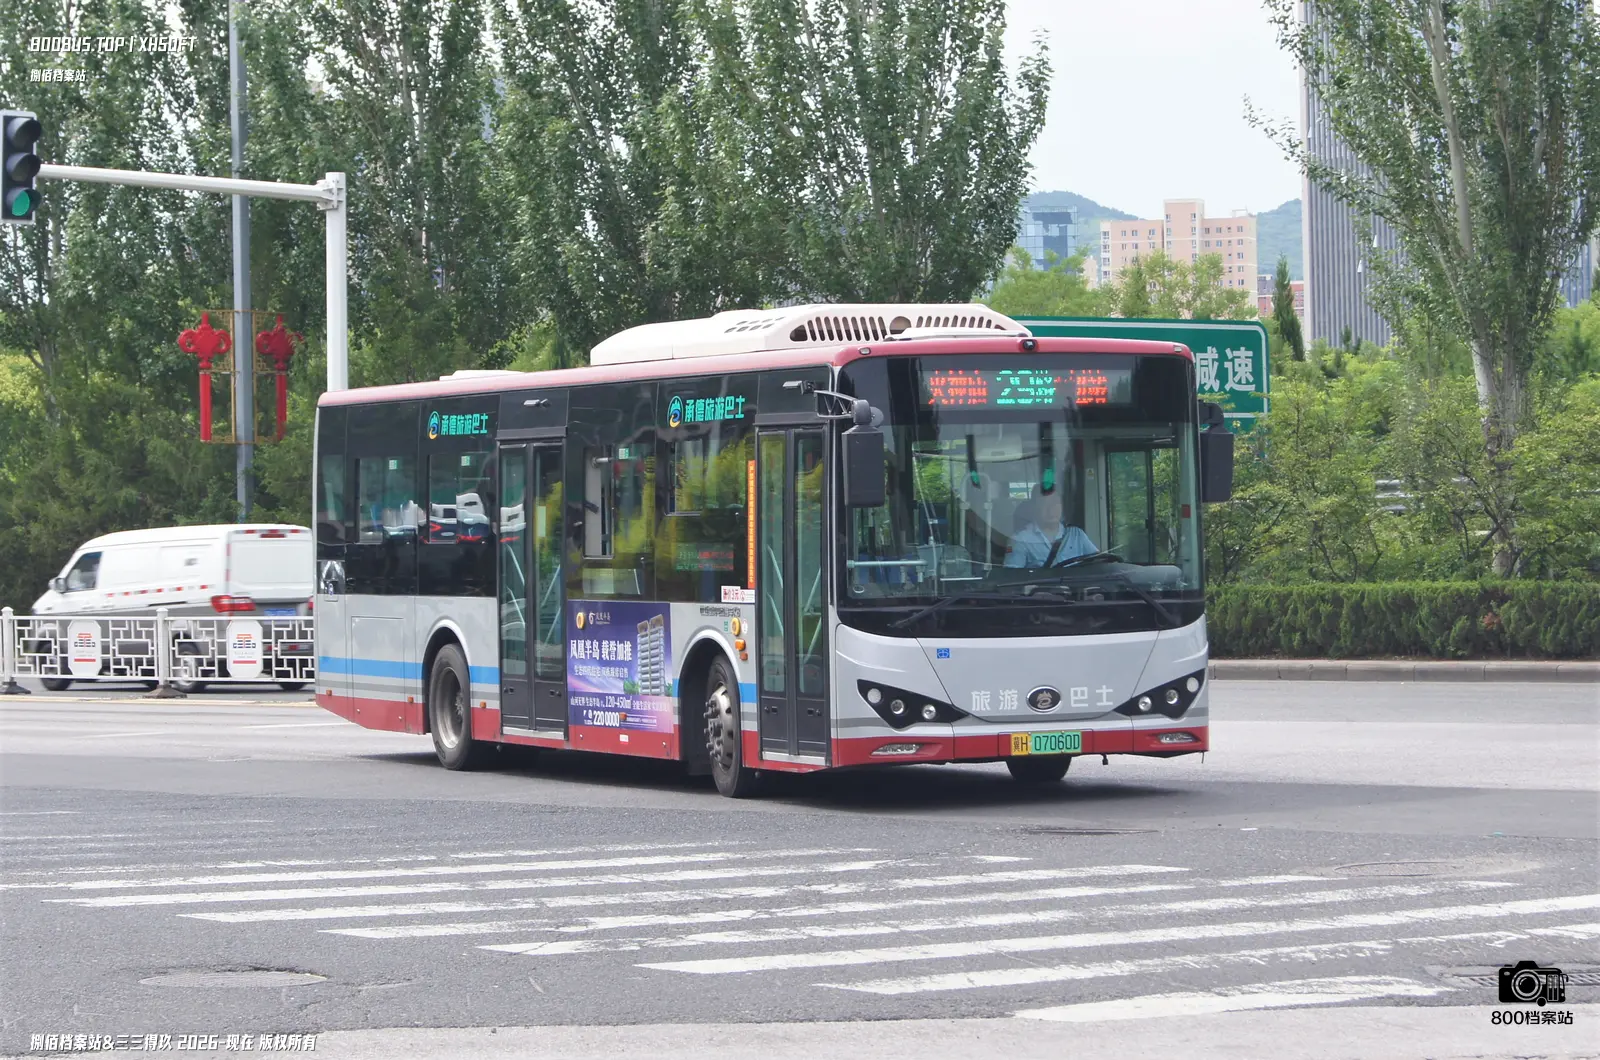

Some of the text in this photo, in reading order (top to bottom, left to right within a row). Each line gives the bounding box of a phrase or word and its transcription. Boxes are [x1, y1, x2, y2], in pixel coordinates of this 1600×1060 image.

[685, 395, 746, 423] 承德旅游巴士
[441, 413, 489, 436] 承德旅游巴士
[971, 685, 1114, 711] 旅游 巴士
[593, 710, 620, 728] 220 0000
